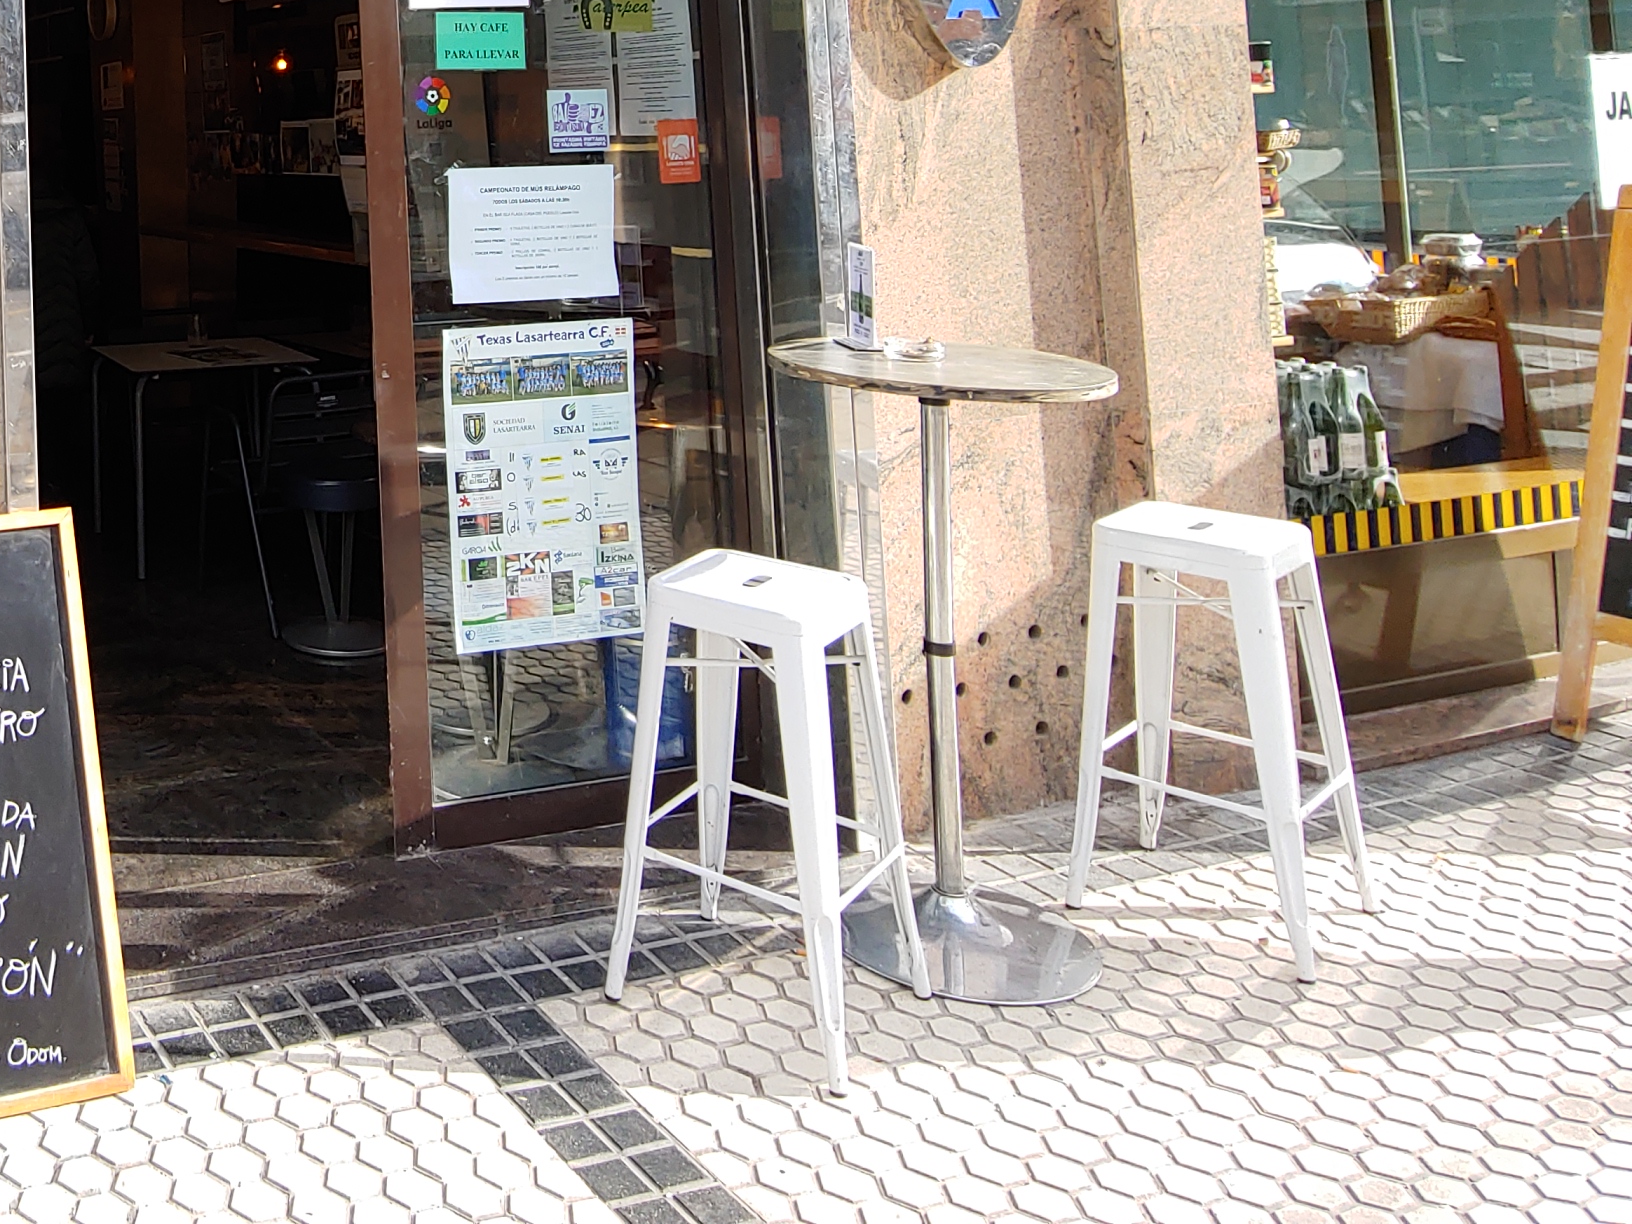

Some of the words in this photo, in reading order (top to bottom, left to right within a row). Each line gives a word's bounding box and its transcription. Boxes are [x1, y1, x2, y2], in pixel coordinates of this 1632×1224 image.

[454, 22, 478, 33] HAY
[480, 22, 509, 33] CAFE
[444, 49, 473, 60] PARA
[476, 49, 520, 60] LLEVAR
[417, 118, 453, 130] LaLiga
[479, 186, 520, 194] CAMPEONATO
[476, 333, 512, 346] Texas
[515, 328, 585, 344] Lasartearra
[588, 325, 612, 339] C.F.
[553, 424, 586, 435] SENAI
[600, 550, 635, 564] IZKINA
[506, 551, 550, 577] 2KN
[600, 565, 632, 574] A2car
[1, 799, 38, 831] DA
